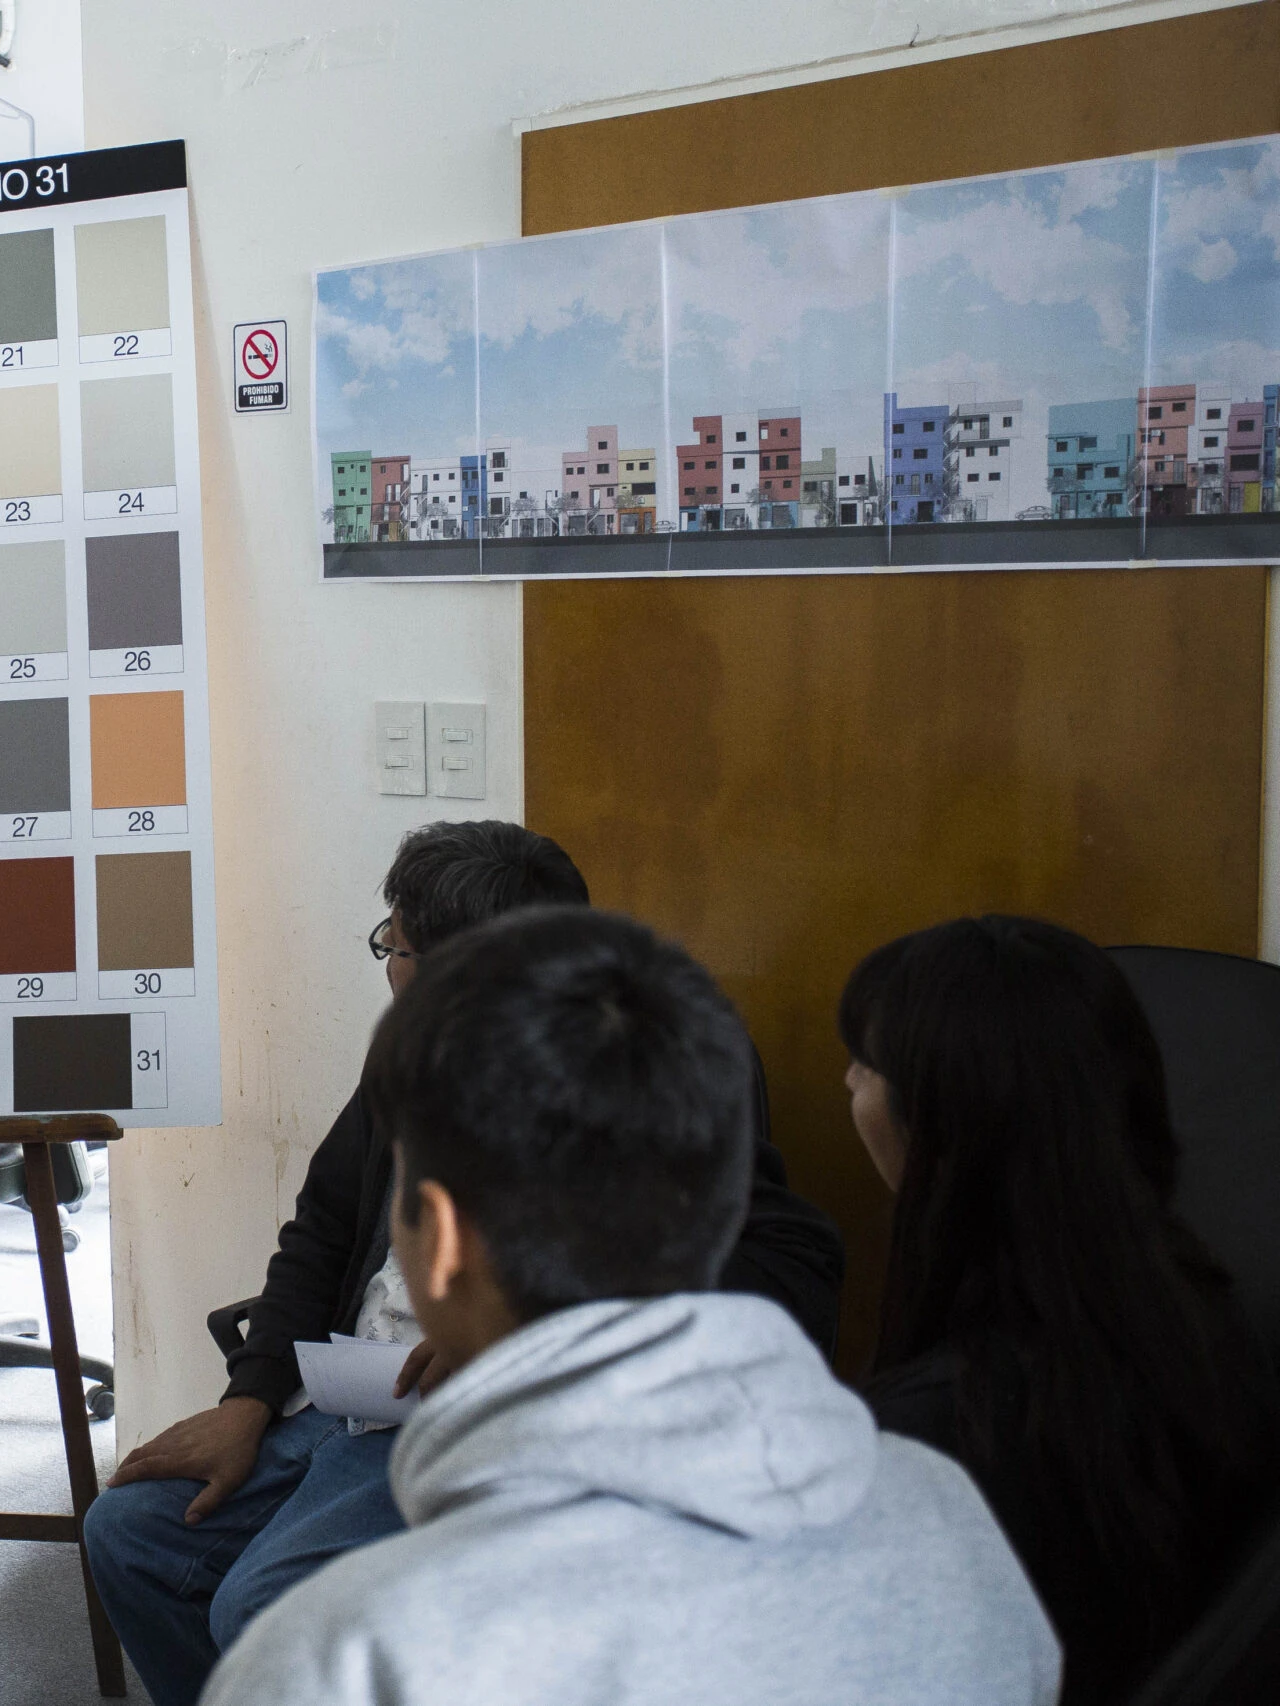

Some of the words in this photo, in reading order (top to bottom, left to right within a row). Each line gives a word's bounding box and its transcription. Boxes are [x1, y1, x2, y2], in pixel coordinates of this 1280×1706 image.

[35, 162, 71, 196] 31
[114, 335, 138, 356] 22
[2, 346, 23, 367] 21
[243, 385, 279, 396] PROHIBIDO
[249, 396, 273, 405] FUMAR
[6, 502, 30, 522] 23
[119, 492, 144, 513] 24
[11, 658, 35, 678] 25
[125, 651, 150, 671] 26
[13, 817, 38, 837] 27
[129, 811, 154, 831] 28
[17, 978, 43, 998] 29
[135, 973, 161, 994] 30
[137, 1050, 160, 1071] 31
